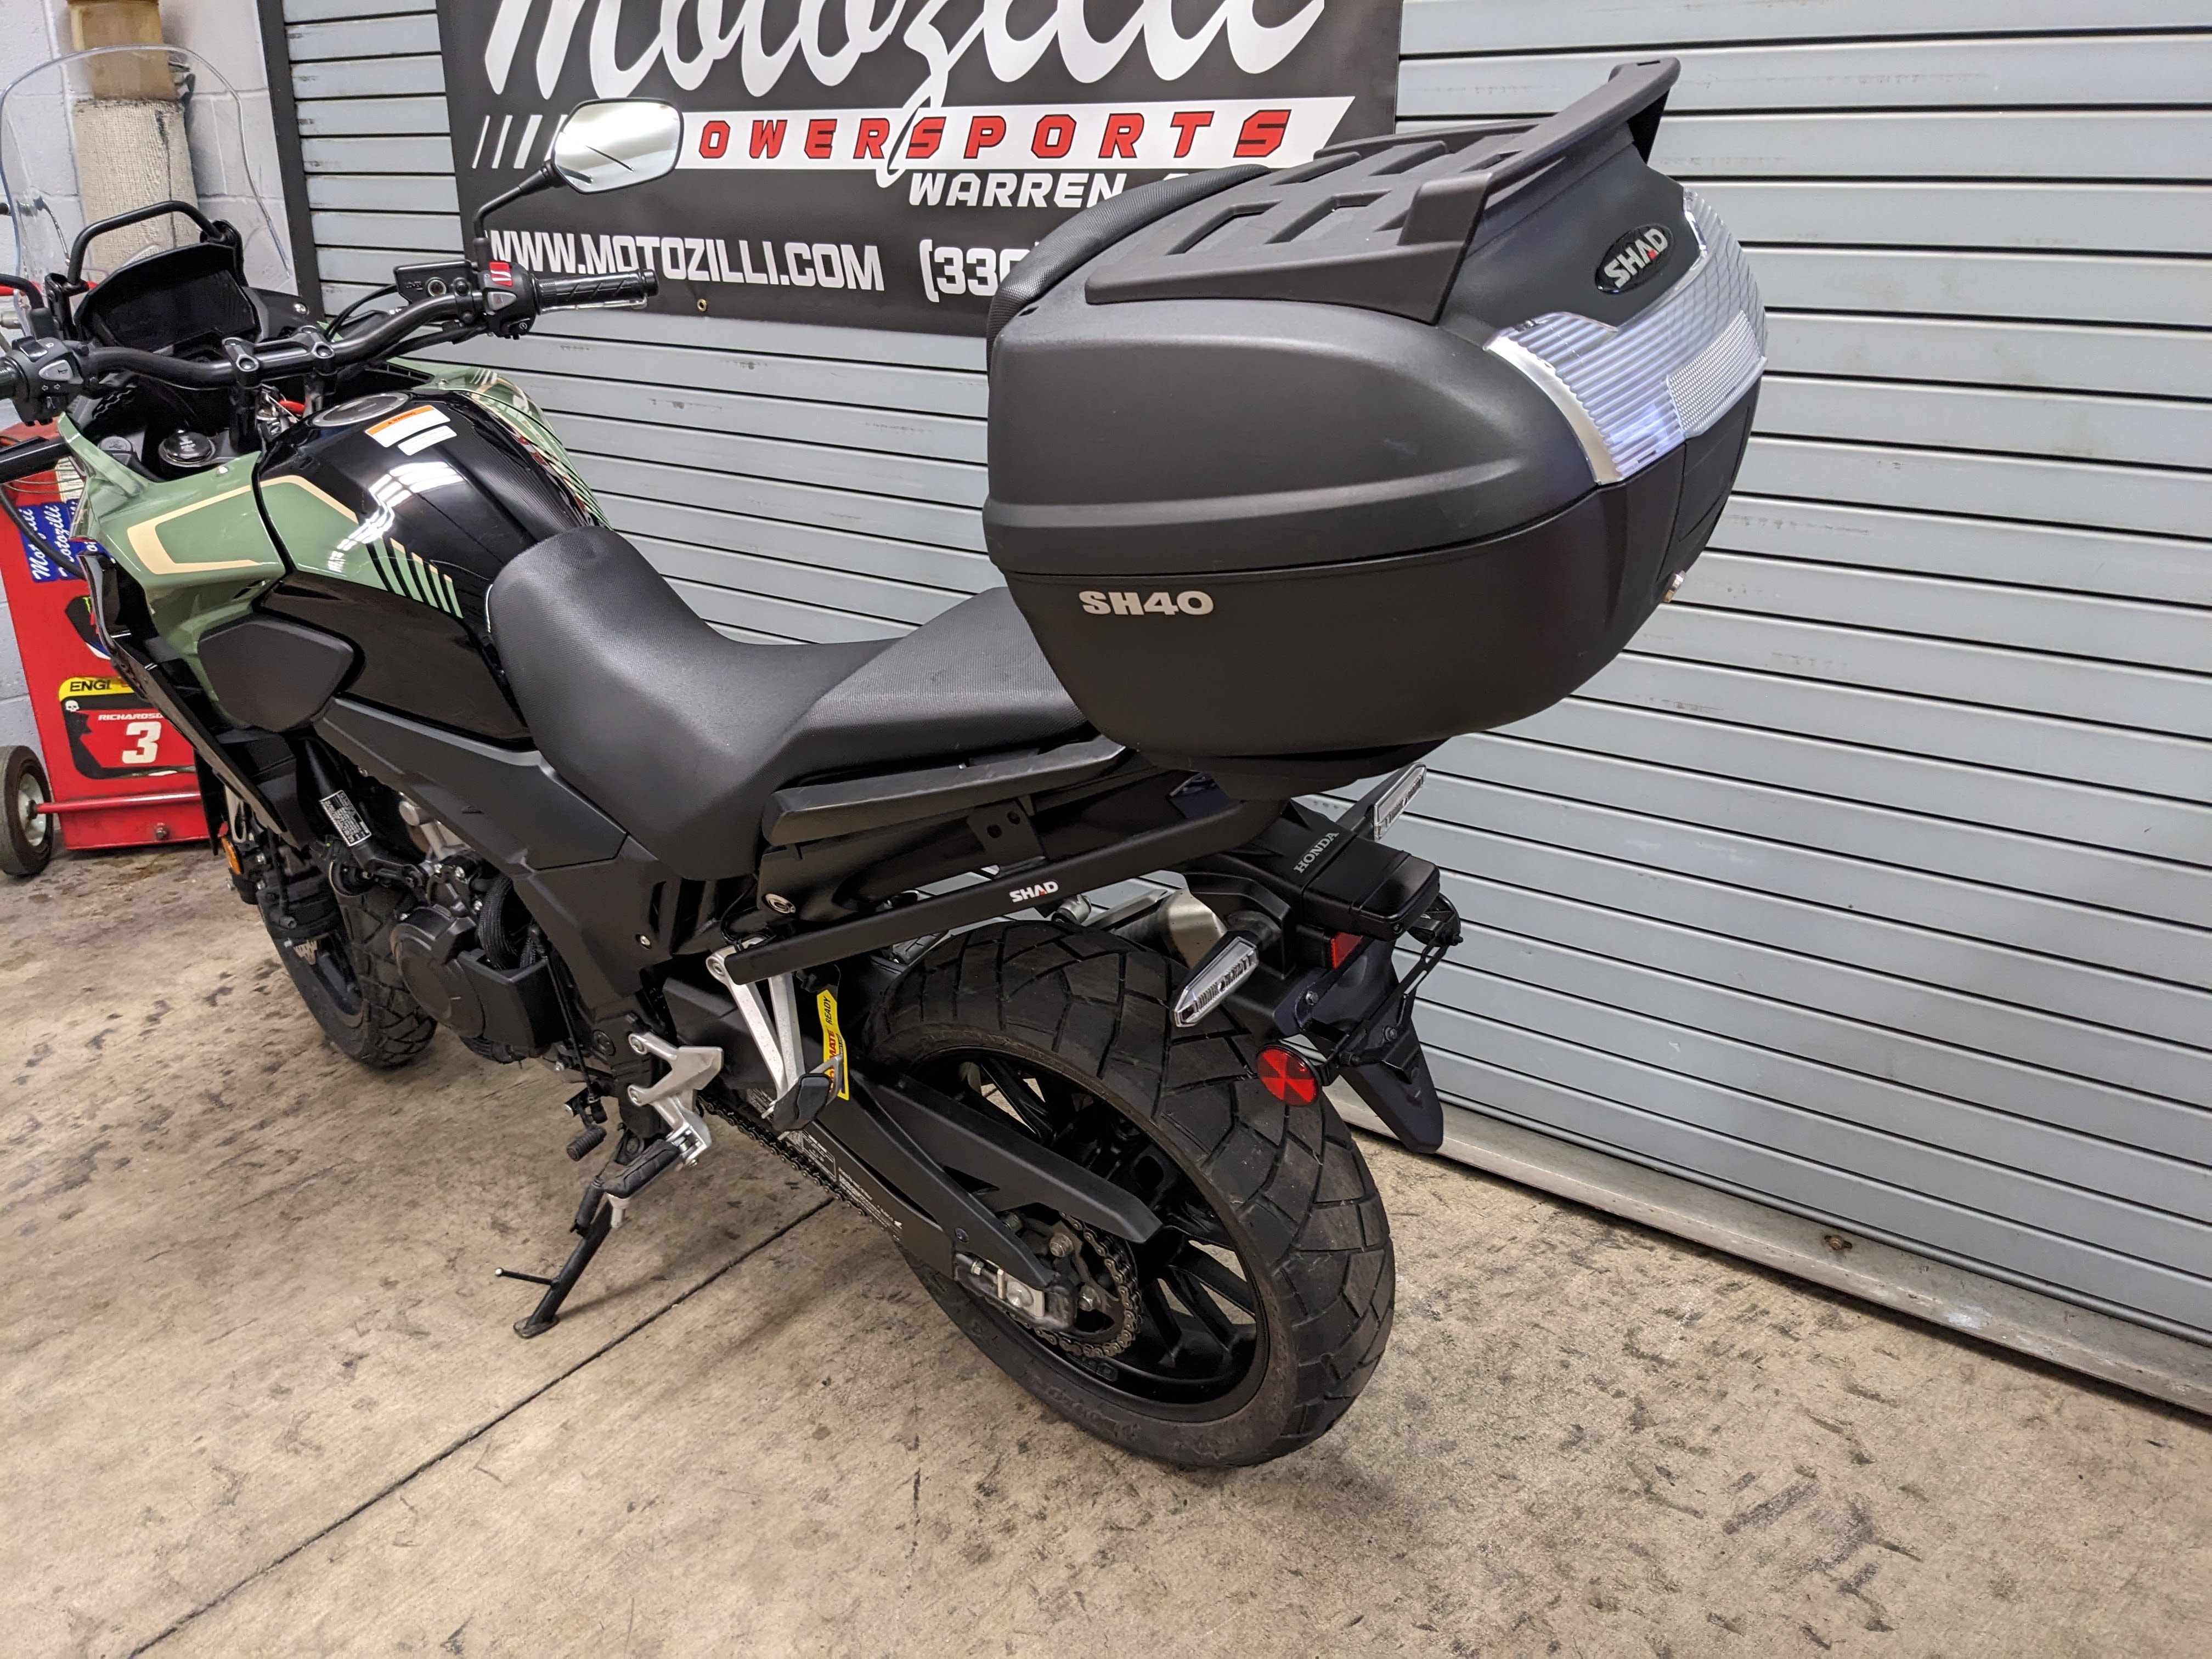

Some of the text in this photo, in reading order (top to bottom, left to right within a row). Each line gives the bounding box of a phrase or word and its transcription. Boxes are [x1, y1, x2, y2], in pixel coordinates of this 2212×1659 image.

[698, 109, 1293, 160] OWERSPORTS
[909, 172, 1127, 208] WARREN
[485, 229, 885, 291] WWW.MOTOZILLI.COM
[1604, 228, 1668, 289] SHAD
[44, 505, 75, 577] otozilli
[1079, 590, 1214, 616] SH40
[122, 721, 161, 764] 3
[1294, 832, 1339, 873] HONDA
[1009, 881, 1059, 902] SHAD
[823, 996, 833, 1025] READY
